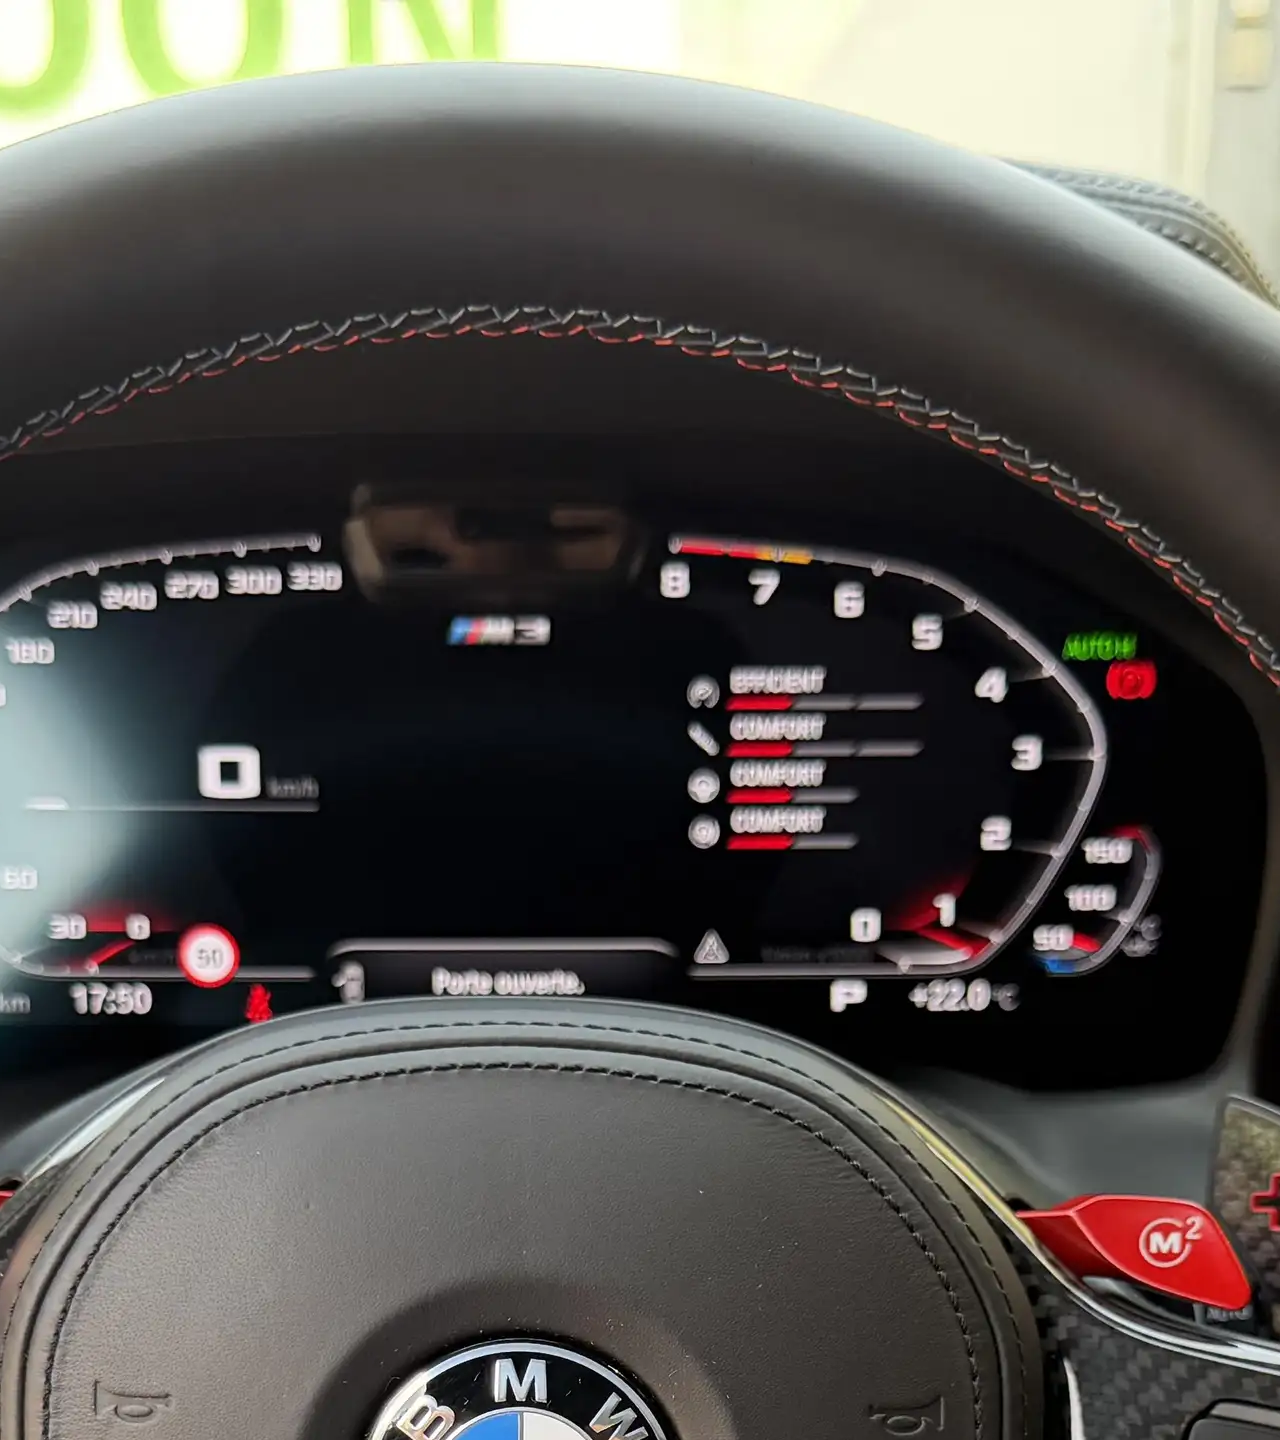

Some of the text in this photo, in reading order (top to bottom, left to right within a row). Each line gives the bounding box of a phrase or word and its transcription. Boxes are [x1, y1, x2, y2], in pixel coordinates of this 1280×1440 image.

[164, 570, 219, 599] 270
[225, 566, 282, 595] 300
[286, 562, 342, 592] 330
[660, 559, 691, 597] 8
[748, 568, 781, 607] 7
[101, 582, 157, 611] 240
[833, 581, 865, 618] 6
[46, 601, 98, 629] 210
[912, 615, 944, 651] 5
[7, 637, 55, 664] 180
[974, 666, 1008, 703] 4
[1011, 735, 1043, 770] 3
[197, 745, 261, 799] 0
[980, 815, 1012, 851] 2
[0, 865, 38, 891] 60
[932, 893, 956, 929] 1
[1064, 884, 1117, 911] 100
[47, 913, 87, 940] 30
[125, 914, 150, 940] 0
[850, 908, 881, 942] 0
[196, 948, 224, 969] 50
[431, 966, 493, 996] Porte
[830, 978, 868, 1012] P
[69, 982, 152, 1015] 17:50
